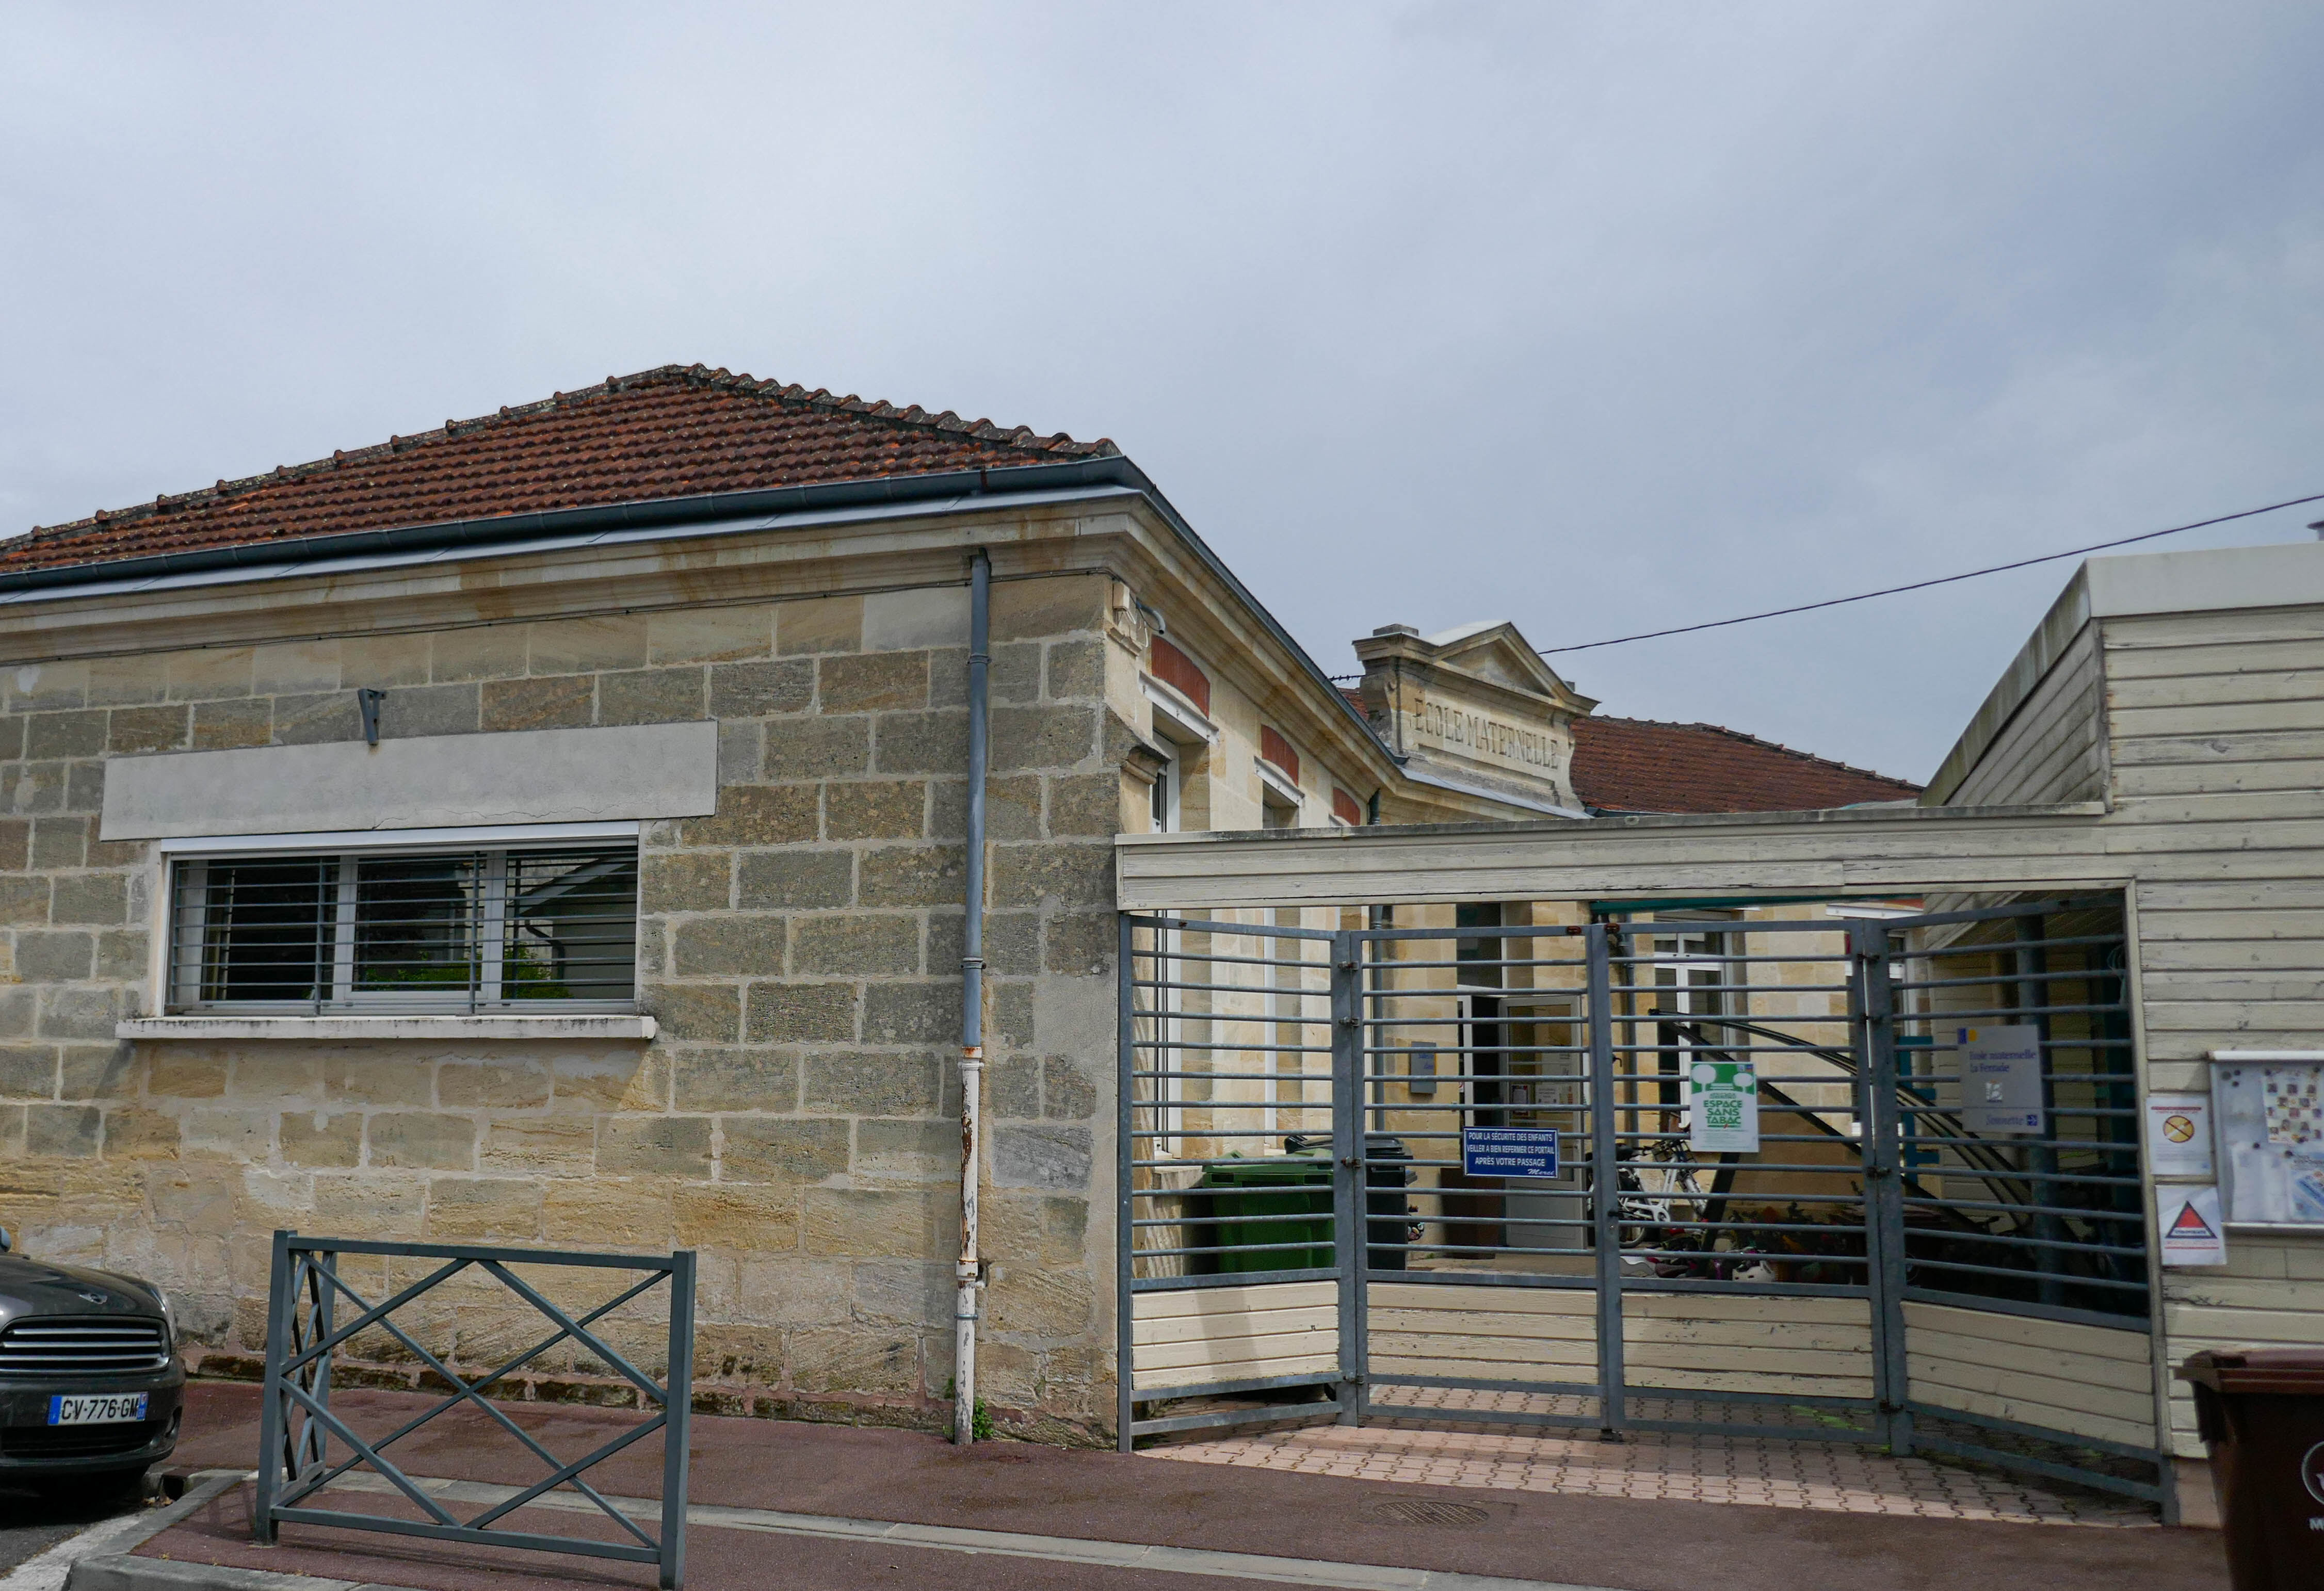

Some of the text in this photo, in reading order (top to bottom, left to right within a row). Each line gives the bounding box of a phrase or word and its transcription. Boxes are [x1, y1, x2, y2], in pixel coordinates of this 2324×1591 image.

[1413, 698, 1559, 769] ECOLE MATERNELLE
[1705, 1116, 1741, 1124] TABAC
[1475, 1156, 1494, 1165] APRÈS
[1517, 1158, 1545, 1166] PASSAGE
[61, 1398, 139, 1420] CV-776-GM
